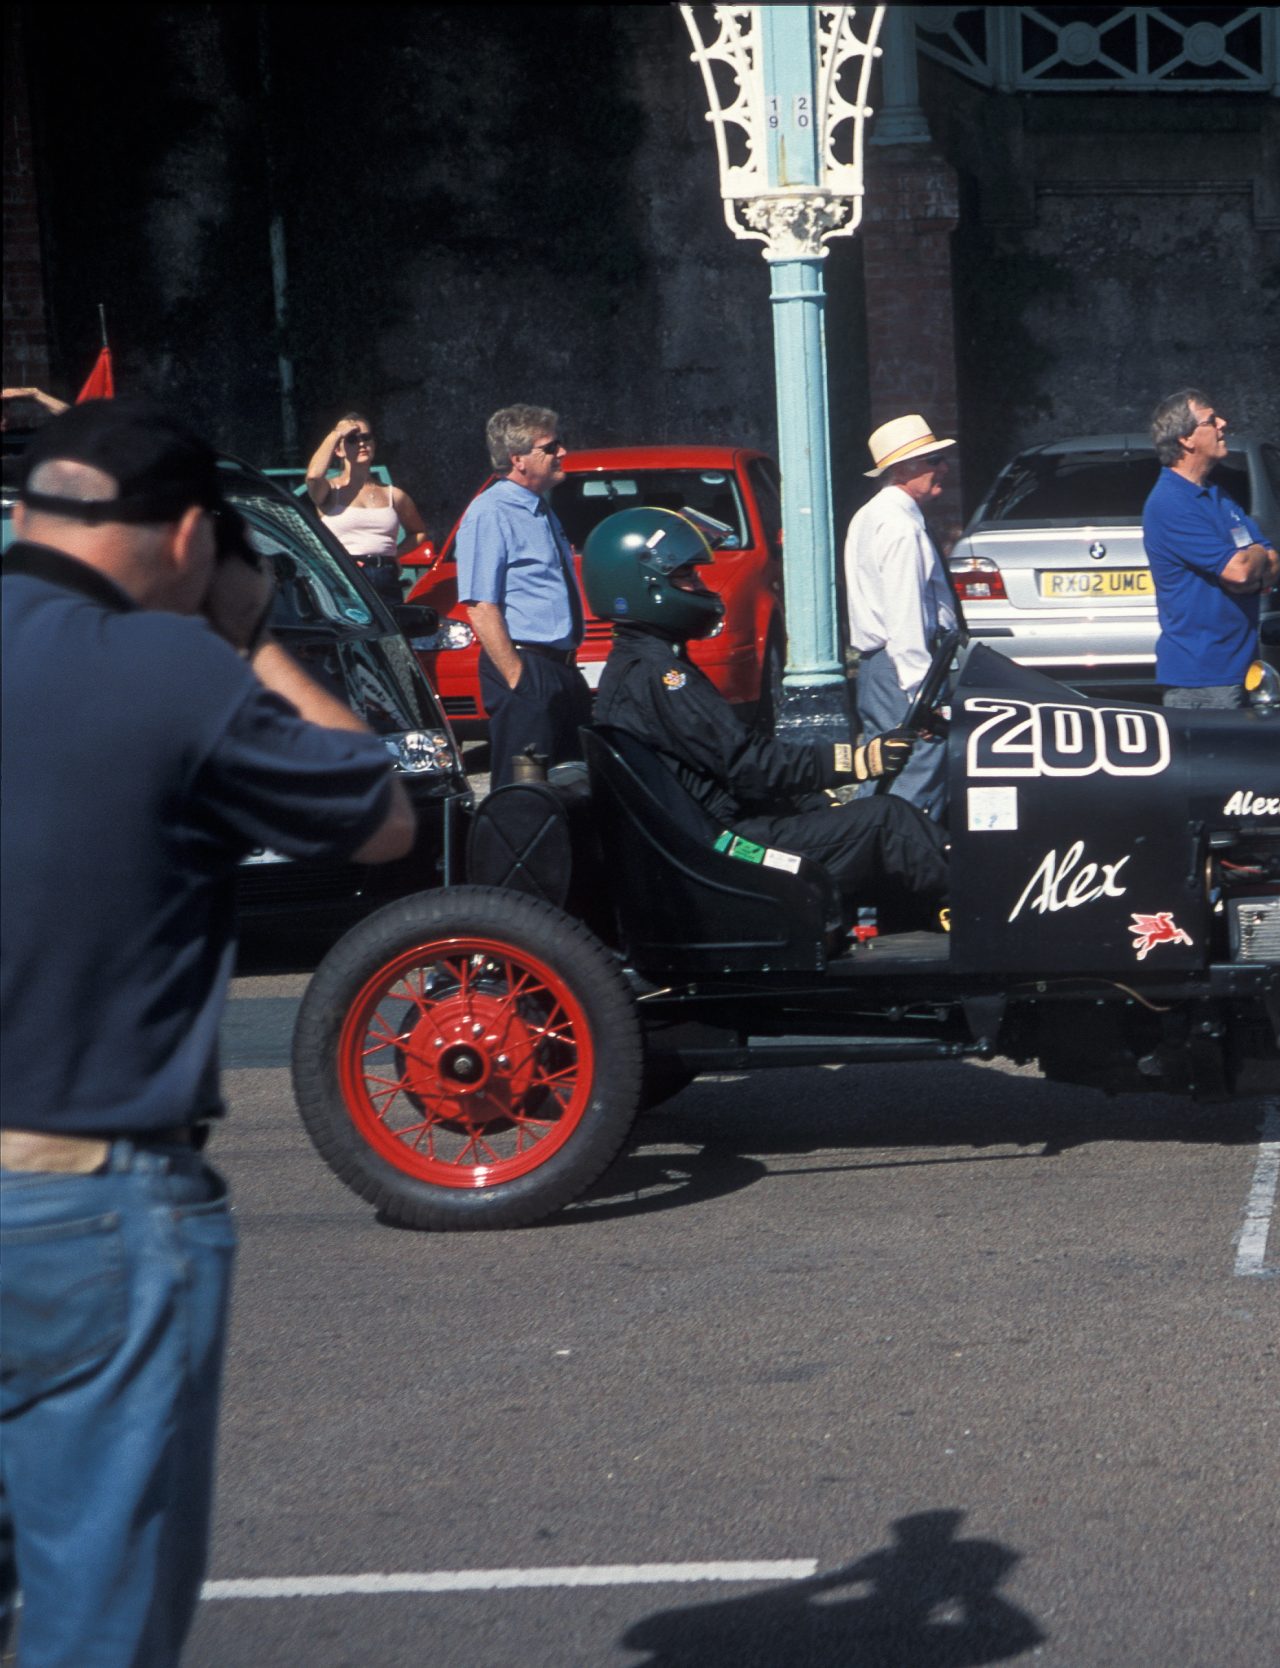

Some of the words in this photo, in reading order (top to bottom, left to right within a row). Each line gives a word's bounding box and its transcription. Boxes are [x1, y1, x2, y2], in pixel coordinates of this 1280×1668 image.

[1052, 574, 1104, 592] RX02
[1109, 573, 1148, 591] UMC
[964, 697, 1171, 777] 200
[1008, 840, 1131, 923] Alex
